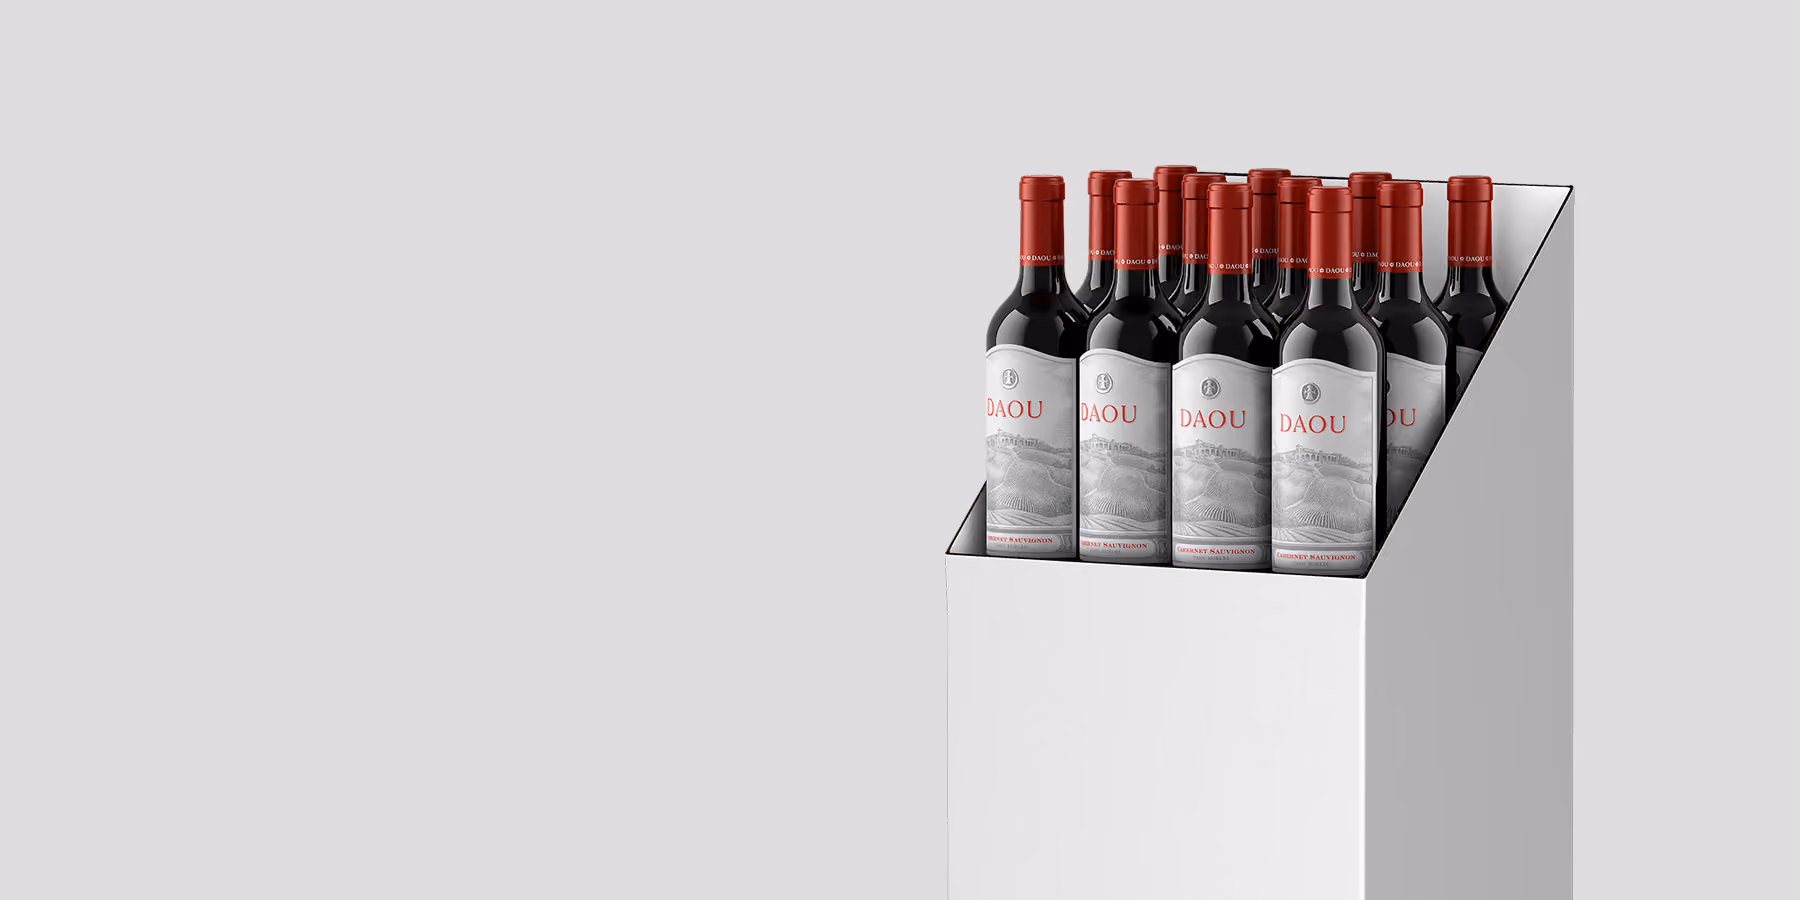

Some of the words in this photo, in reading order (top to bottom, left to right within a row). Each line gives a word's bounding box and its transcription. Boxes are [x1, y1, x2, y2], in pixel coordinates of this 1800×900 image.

[987, 397, 1042, 419] DAOU
[1081, 402, 1137, 423] DAOU
[1387, 408, 1416, 427] OU
[1180, 408, 1246, 429] DAOU
[1280, 413, 1346, 433] DAOU
[1008, 536, 1053, 544] SAUVIGNON
[1103, 541, 1148, 549] SAUVIGNON
[1209, 547, 1256, 555] SAUVIGNON
[1309, 553, 1356, 561] SAUVIGNON
